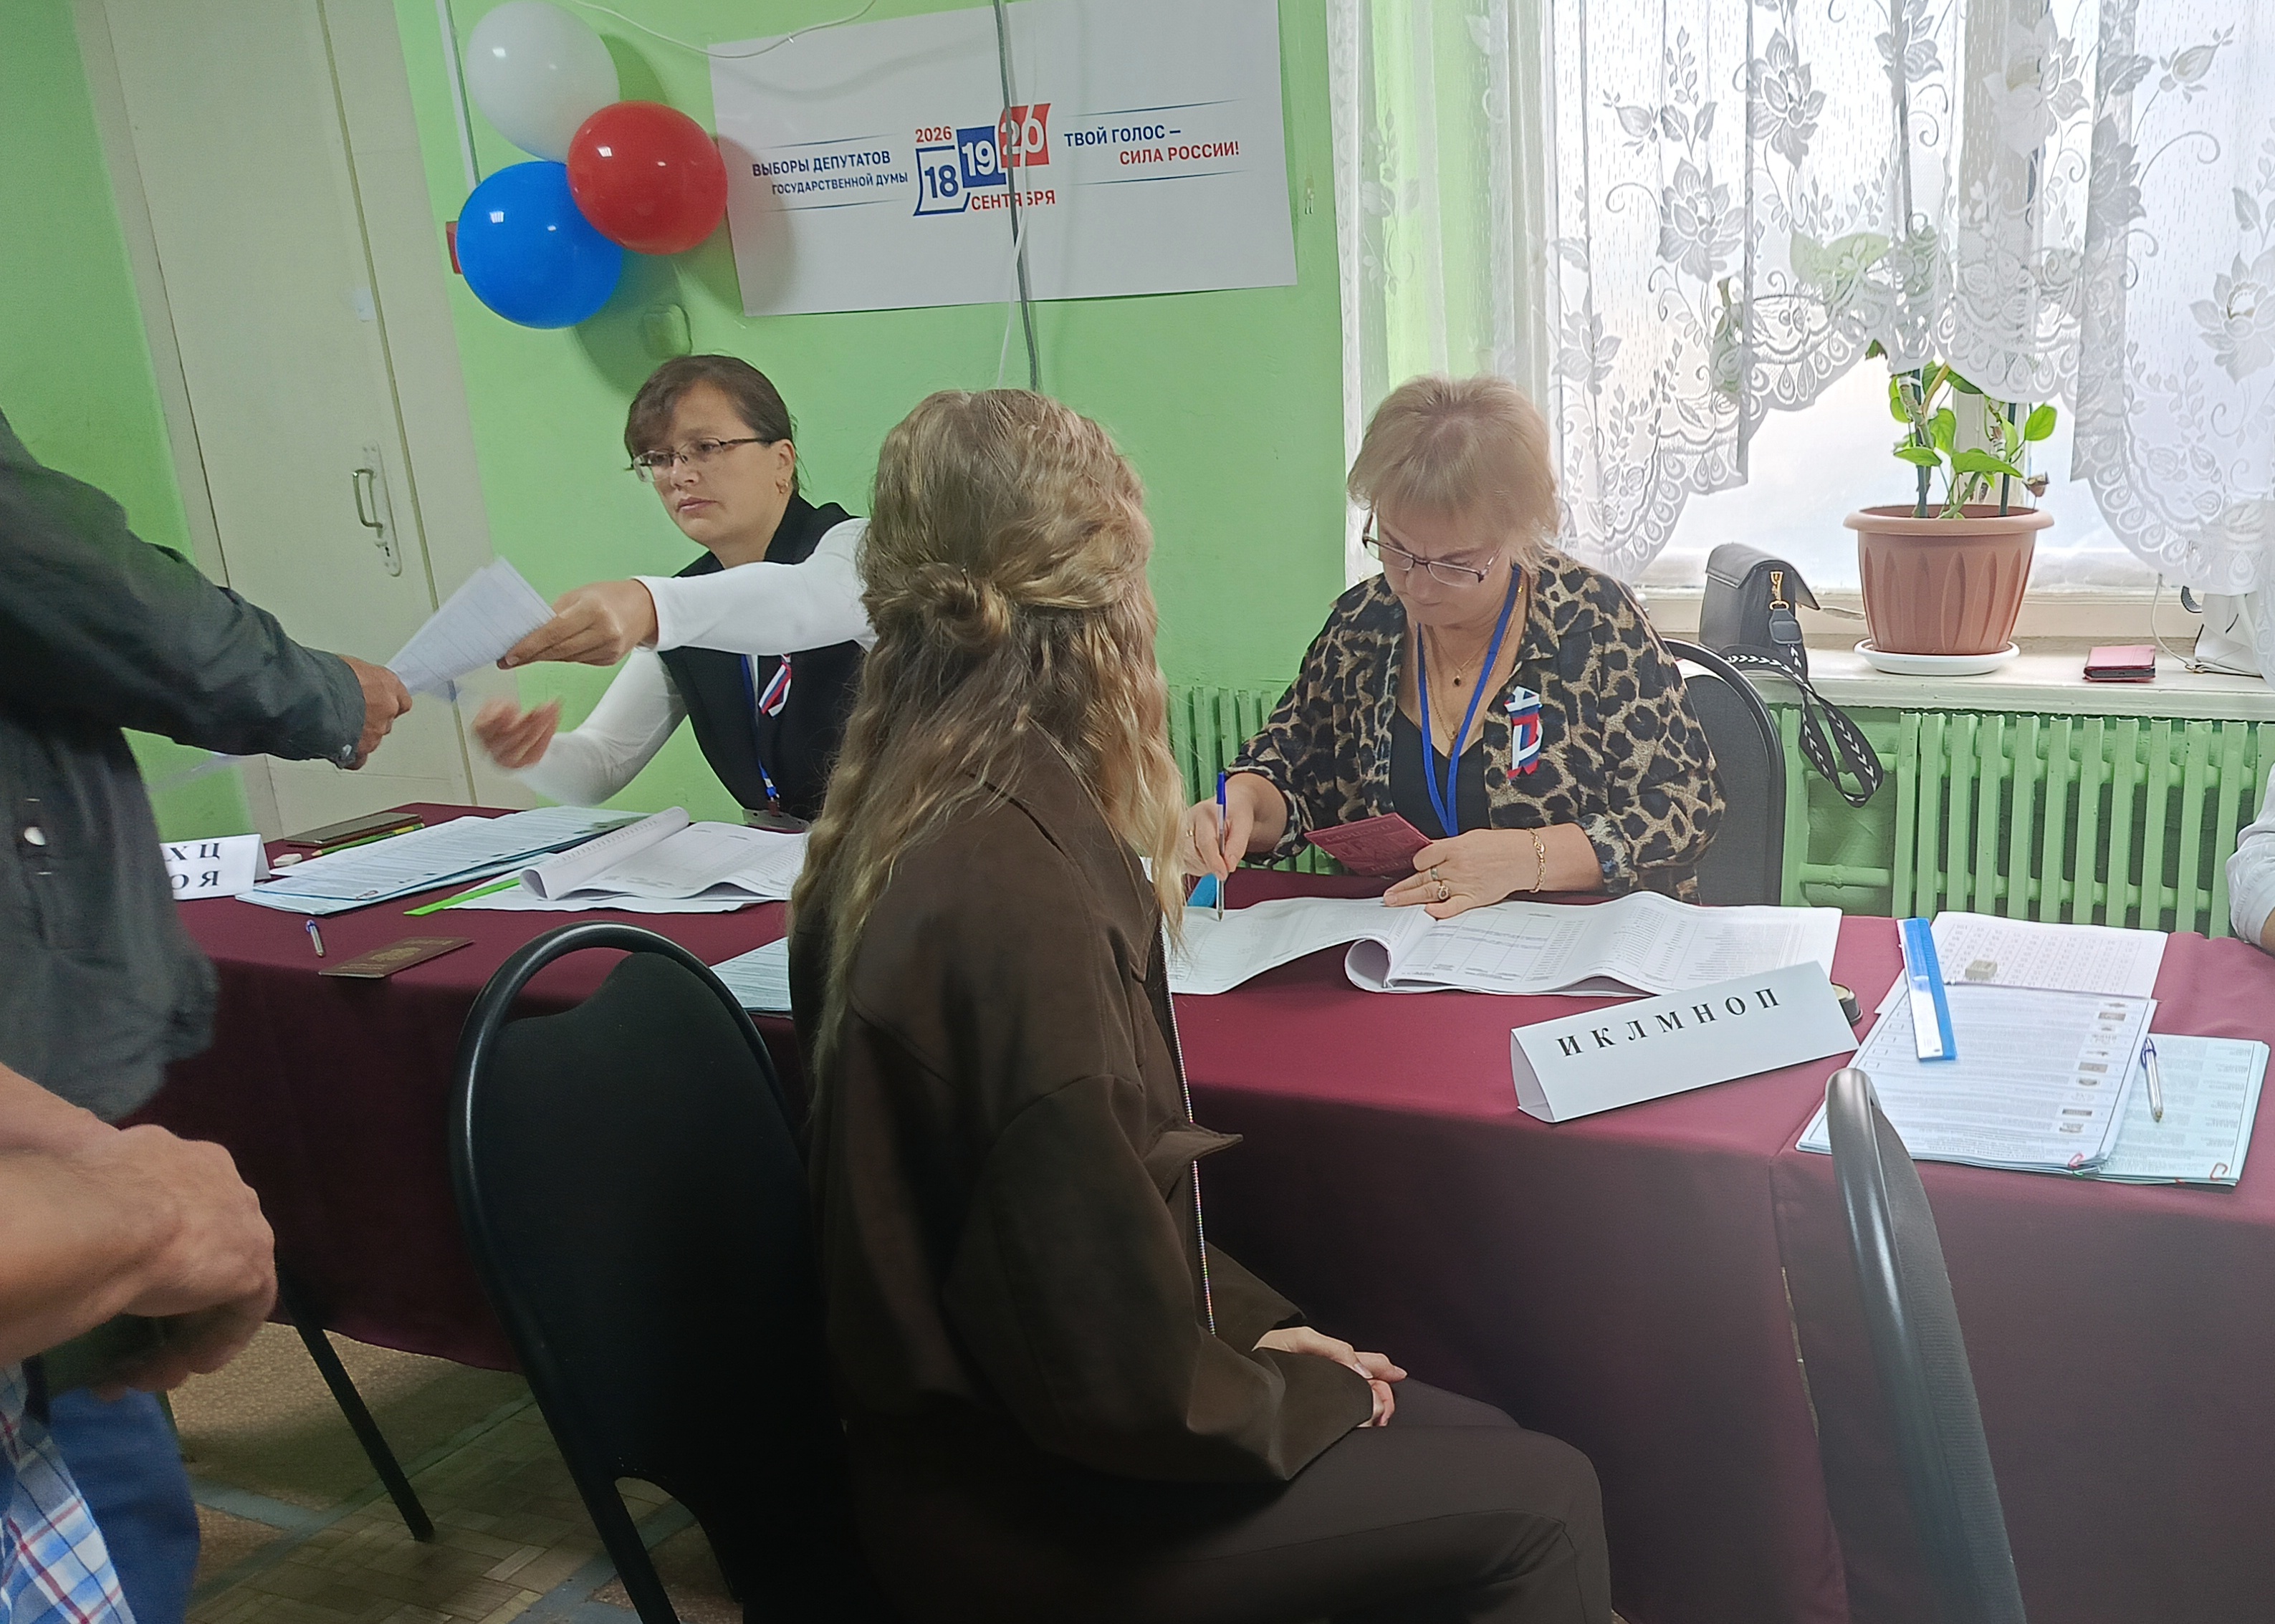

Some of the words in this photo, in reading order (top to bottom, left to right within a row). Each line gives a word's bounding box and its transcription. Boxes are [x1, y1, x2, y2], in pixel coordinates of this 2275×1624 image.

[915, 125, 952, 143] 2026
[1064, 126, 1108, 147] ТВОЙ
[1111, 124, 1165, 143] ГОЛОС
[752, 158, 810, 177] ВЫБОРЫ
[813, 150, 891, 173] ДЕПУТАТОВ
[962, 140, 997, 176] 19
[1119, 148, 1164, 165] СИЛА
[1167, 140, 1240, 161] РОССИИ!
[772, 173, 873, 195] ГОСУДАРСТВЕННОЙ
[876, 172, 909, 187] ДУМЫ
[924, 164, 959, 198] 18
[197, 842, 221, 860] Ц
[197, 870, 221, 888] Я
